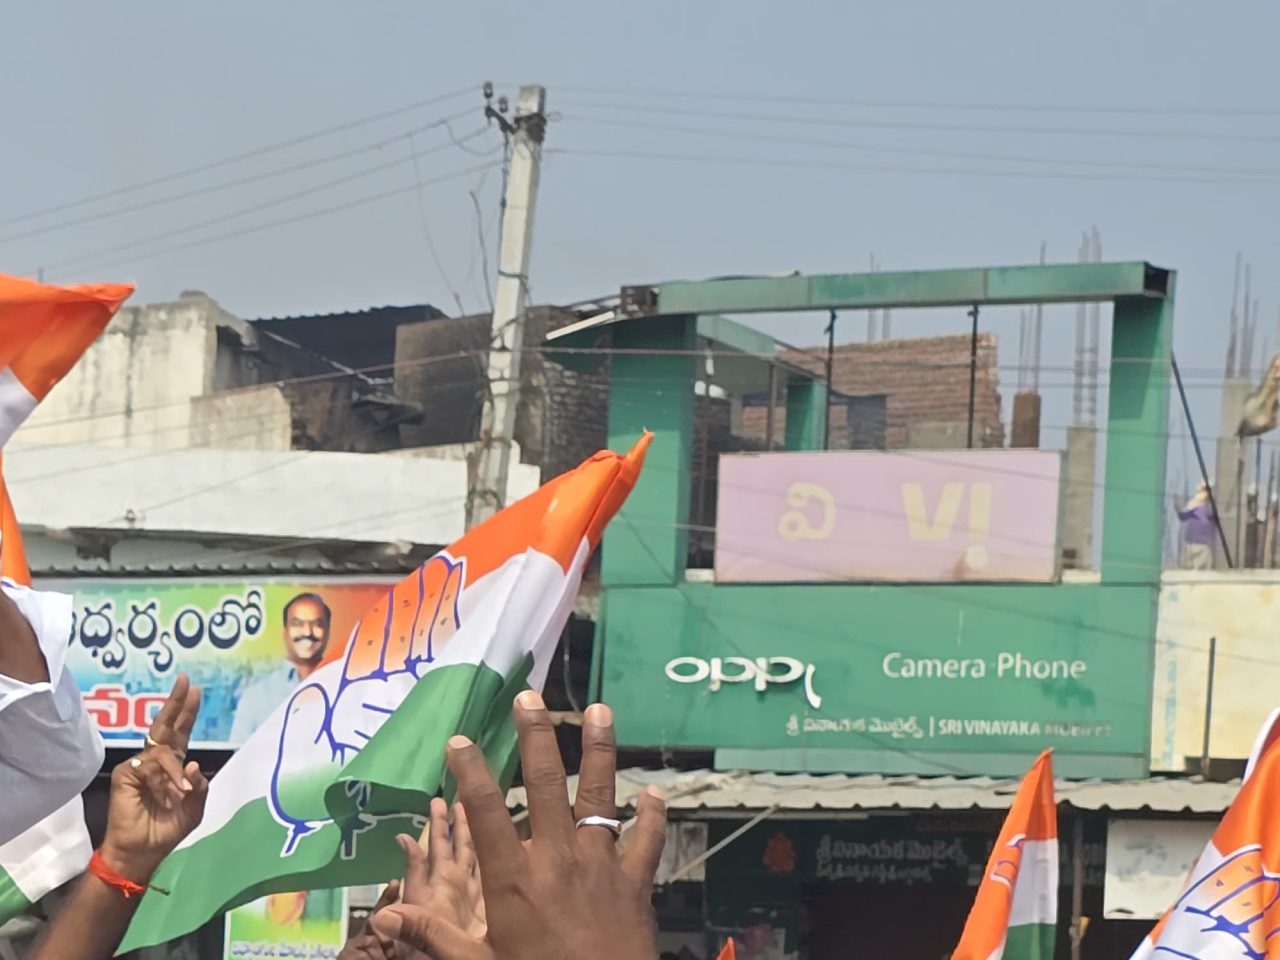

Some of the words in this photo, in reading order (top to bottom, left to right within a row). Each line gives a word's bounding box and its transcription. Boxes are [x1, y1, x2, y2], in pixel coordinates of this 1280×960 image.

[69, 589, 263, 673] ధ్వర్యంలో
[882, 652, 986, 679] Camera
[997, 652, 1087, 679] Phone
[938, 719, 962, 736] SRI
[964, 719, 1041, 736] VINAYAKA
